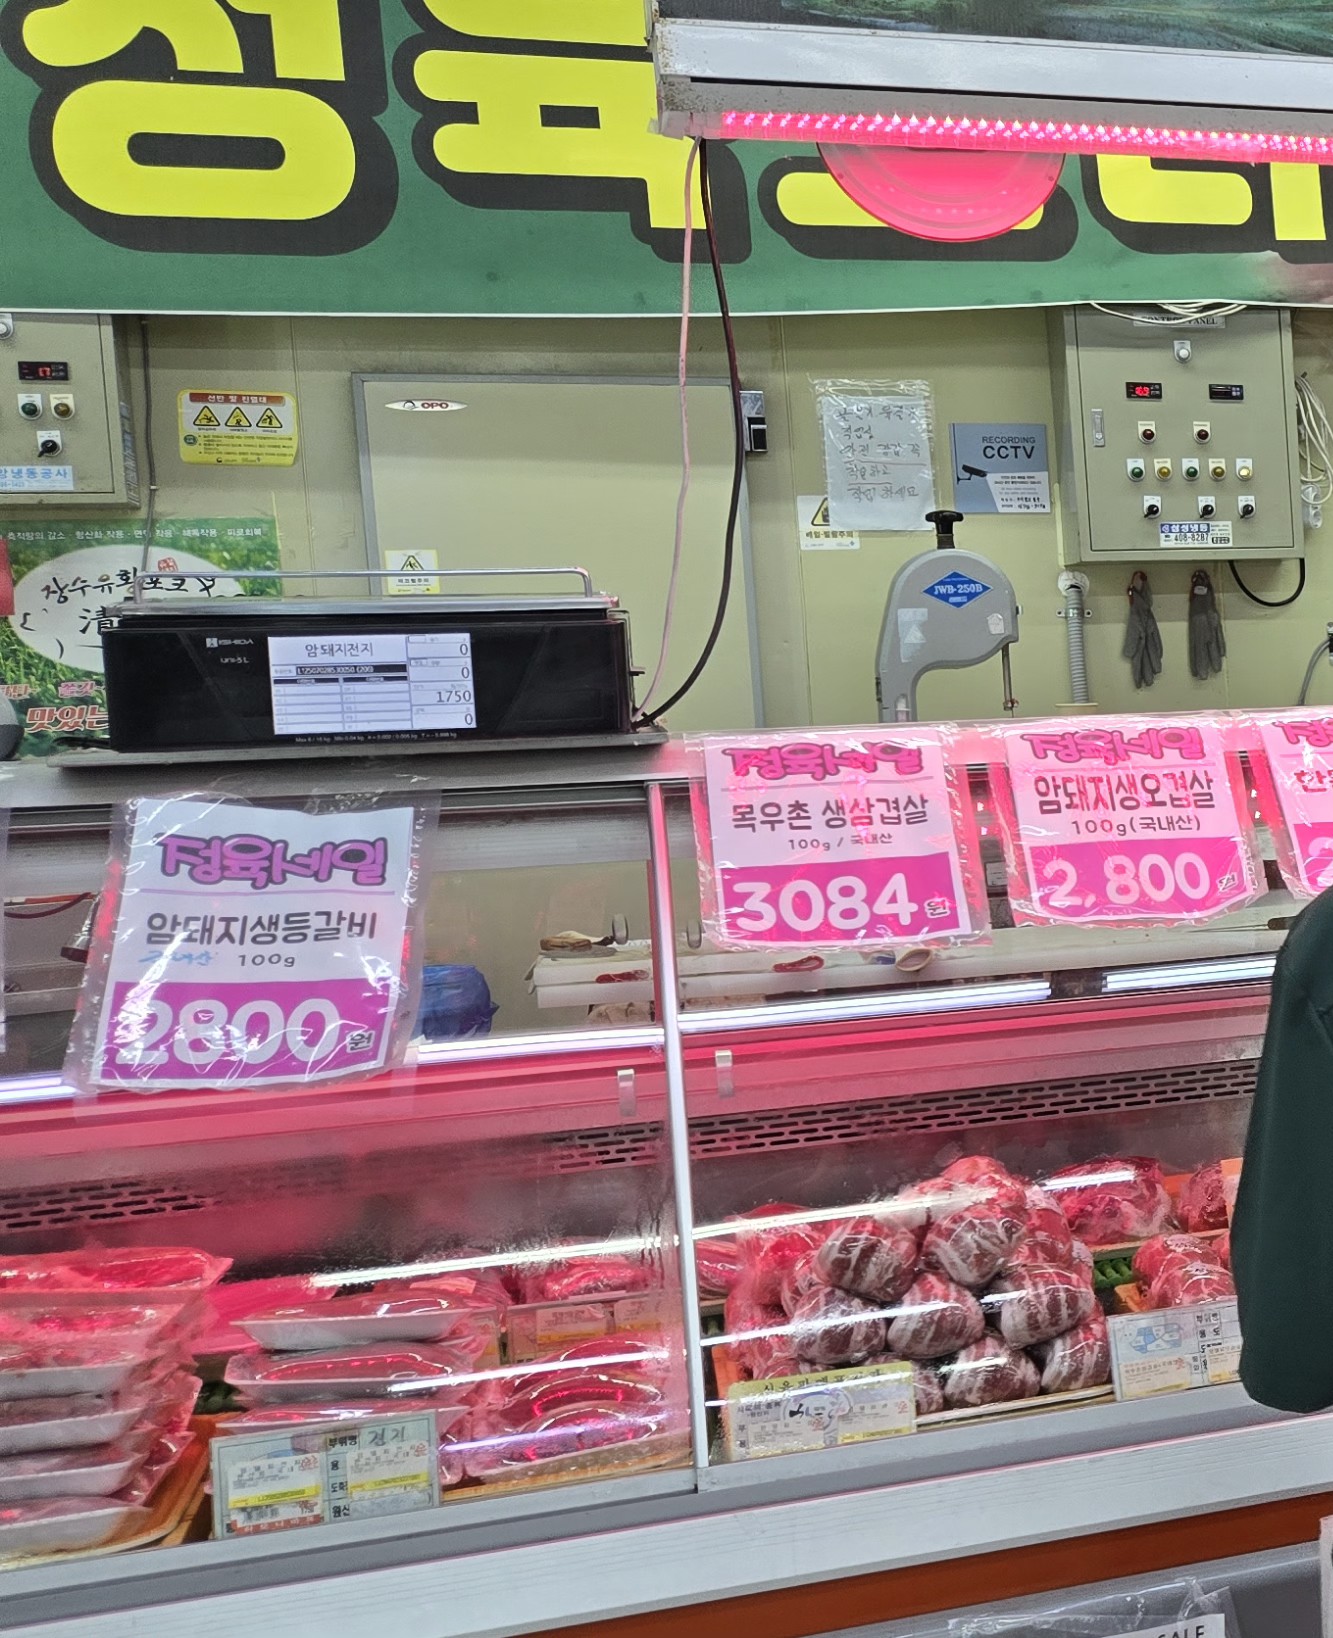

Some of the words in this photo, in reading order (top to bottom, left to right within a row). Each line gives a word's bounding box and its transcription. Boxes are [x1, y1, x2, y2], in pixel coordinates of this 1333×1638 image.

[982, 436, 1036, 444] RECORDING
[982, 445, 1035, 459] CCTV
[933, 583, 983, 595] JWB-250B
[459, 643, 469, 656] 0
[461, 667, 470, 679] 0
[436, 690, 472, 703] 1750
[24, 703, 109, 736] 맛있는
[464, 714, 473, 726] 0
[1021, 726, 1207, 765] 정육세일
[721, 740, 924, 781] 정육세일
[1032, 769, 1217, 815] 암돼지생오겹살
[730, 802, 813, 834] 목우촌
[821, 795, 930, 829] 생삼겹살
[787, 836, 832, 851] 100g
[850, 832, 894, 846] 국내산
[155, 833, 389, 891] 정육세일
[731, 872, 920, 933] 3084
[146, 909, 378, 947] 암돼지생등갈비
[238, 952, 297, 969] 100g
[114, 998, 343, 1067] 2800
[346, 1030, 375, 1053] 원
